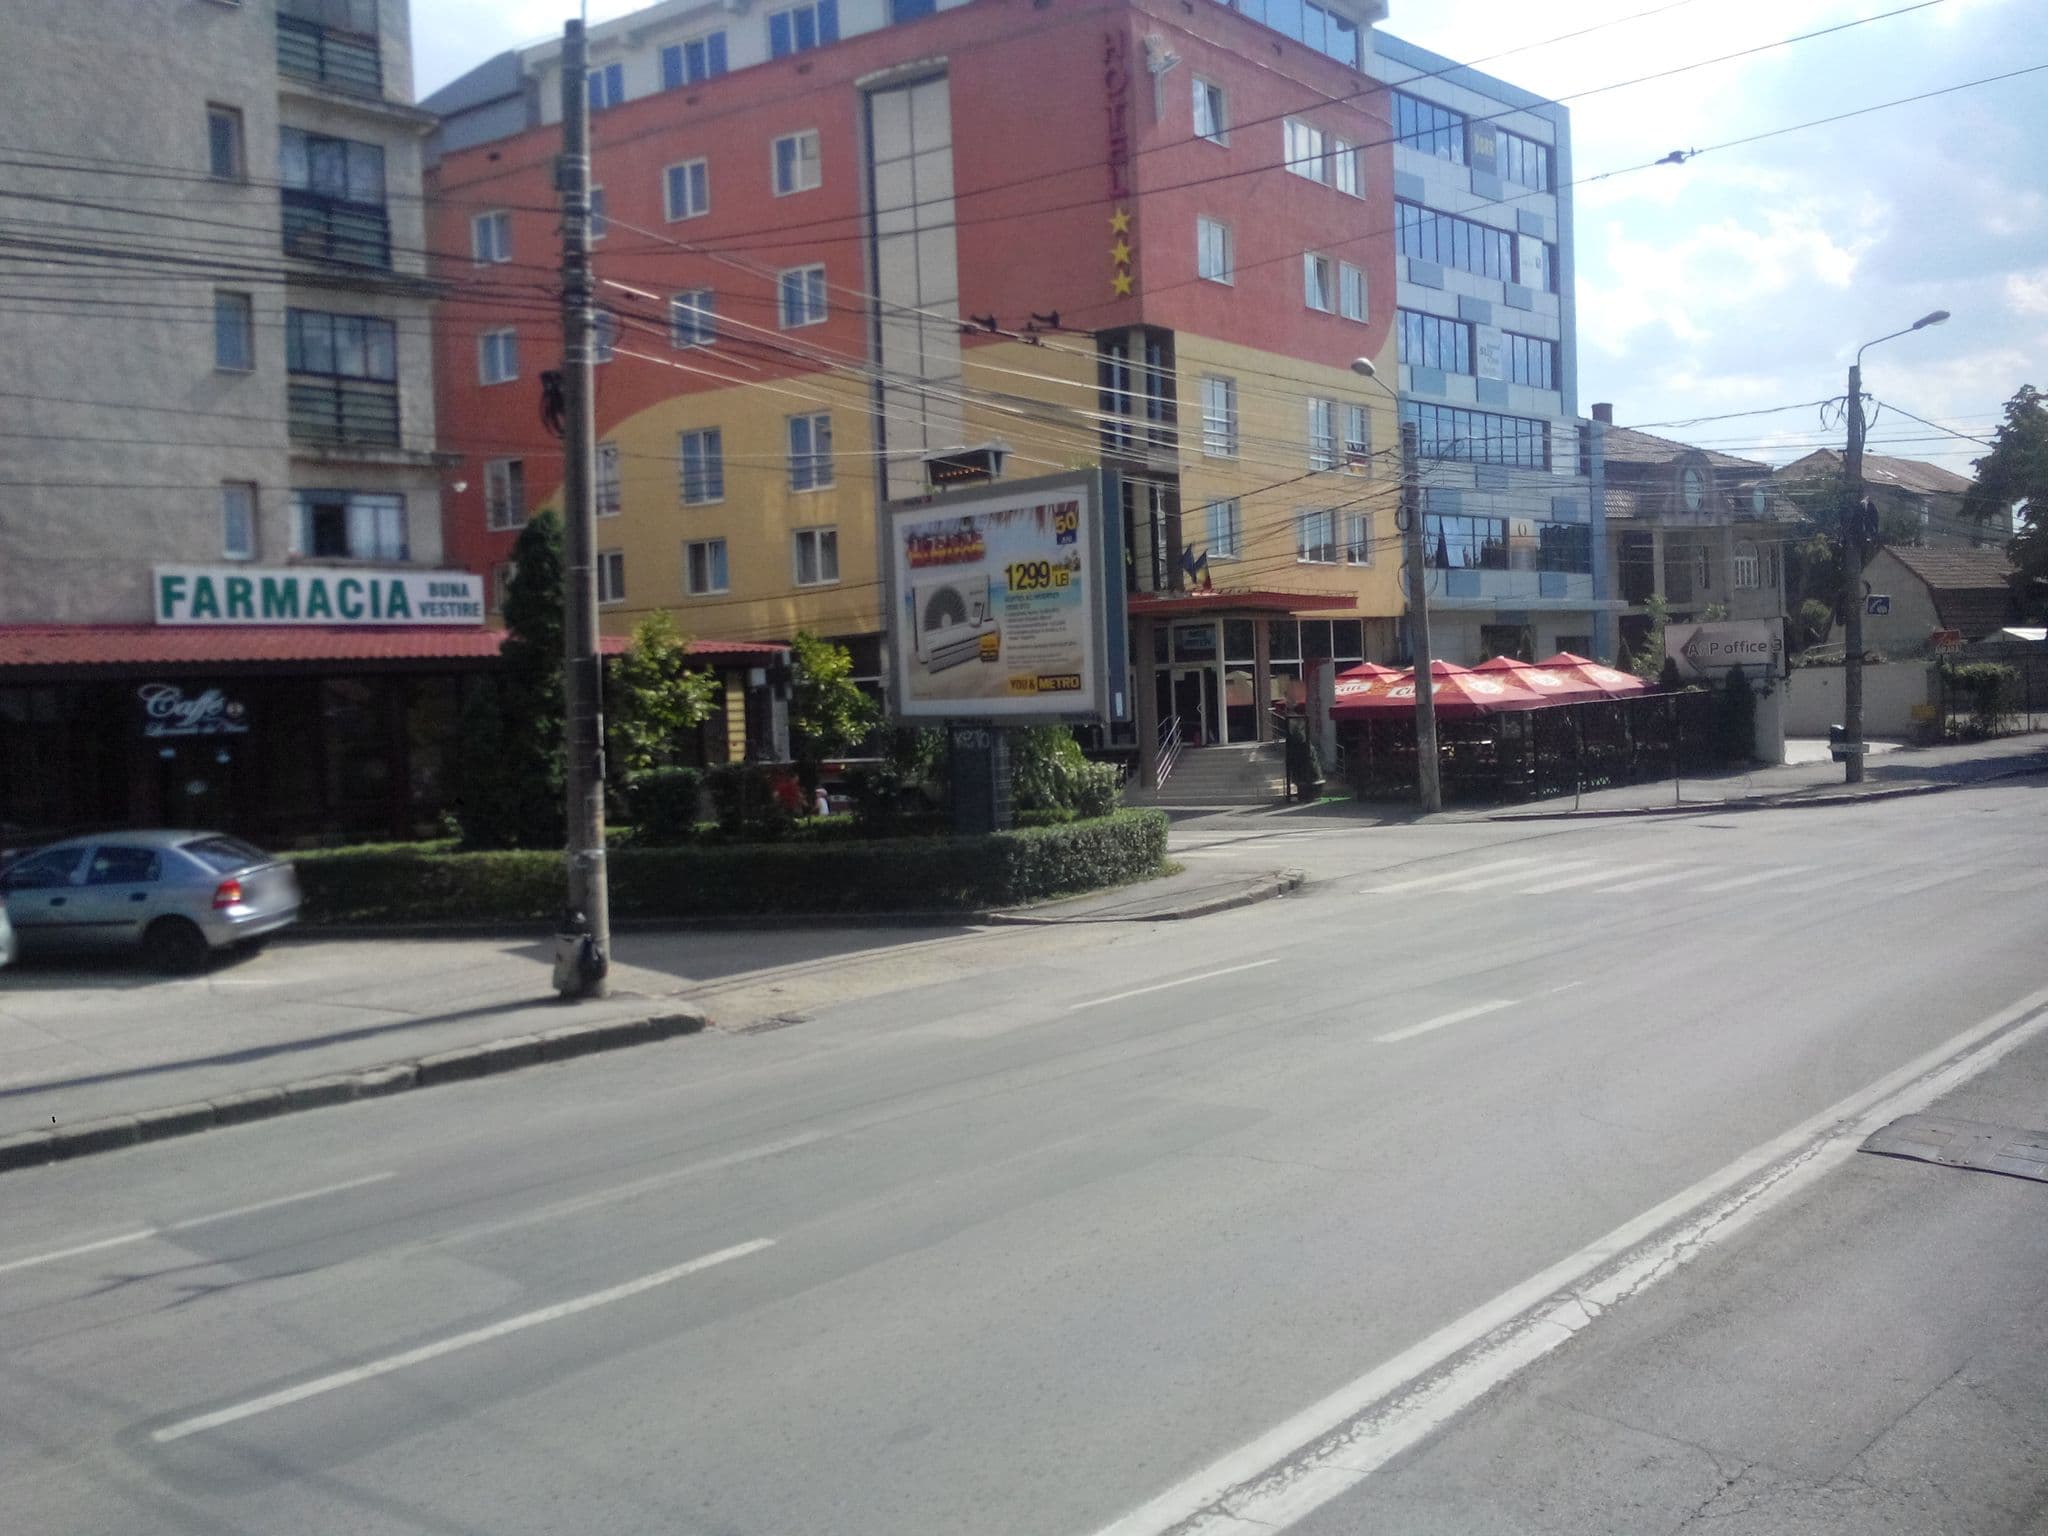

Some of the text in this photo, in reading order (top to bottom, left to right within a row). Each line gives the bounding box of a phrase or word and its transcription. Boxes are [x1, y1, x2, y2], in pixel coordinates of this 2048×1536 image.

[1055, 514, 1078, 534] 50
[1004, 561, 1051, 591] 1299
[1056, 573, 1069, 587] LEI
[159, 575, 412, 619] FARMACIA
[428, 582, 470, 598] BUNA
[419, 601, 481, 618] VESTIRE
[1724, 641, 1768, 654] office
[1010, 679, 1027, 690] YOU
[1038, 675, 1080, 691] METRO
